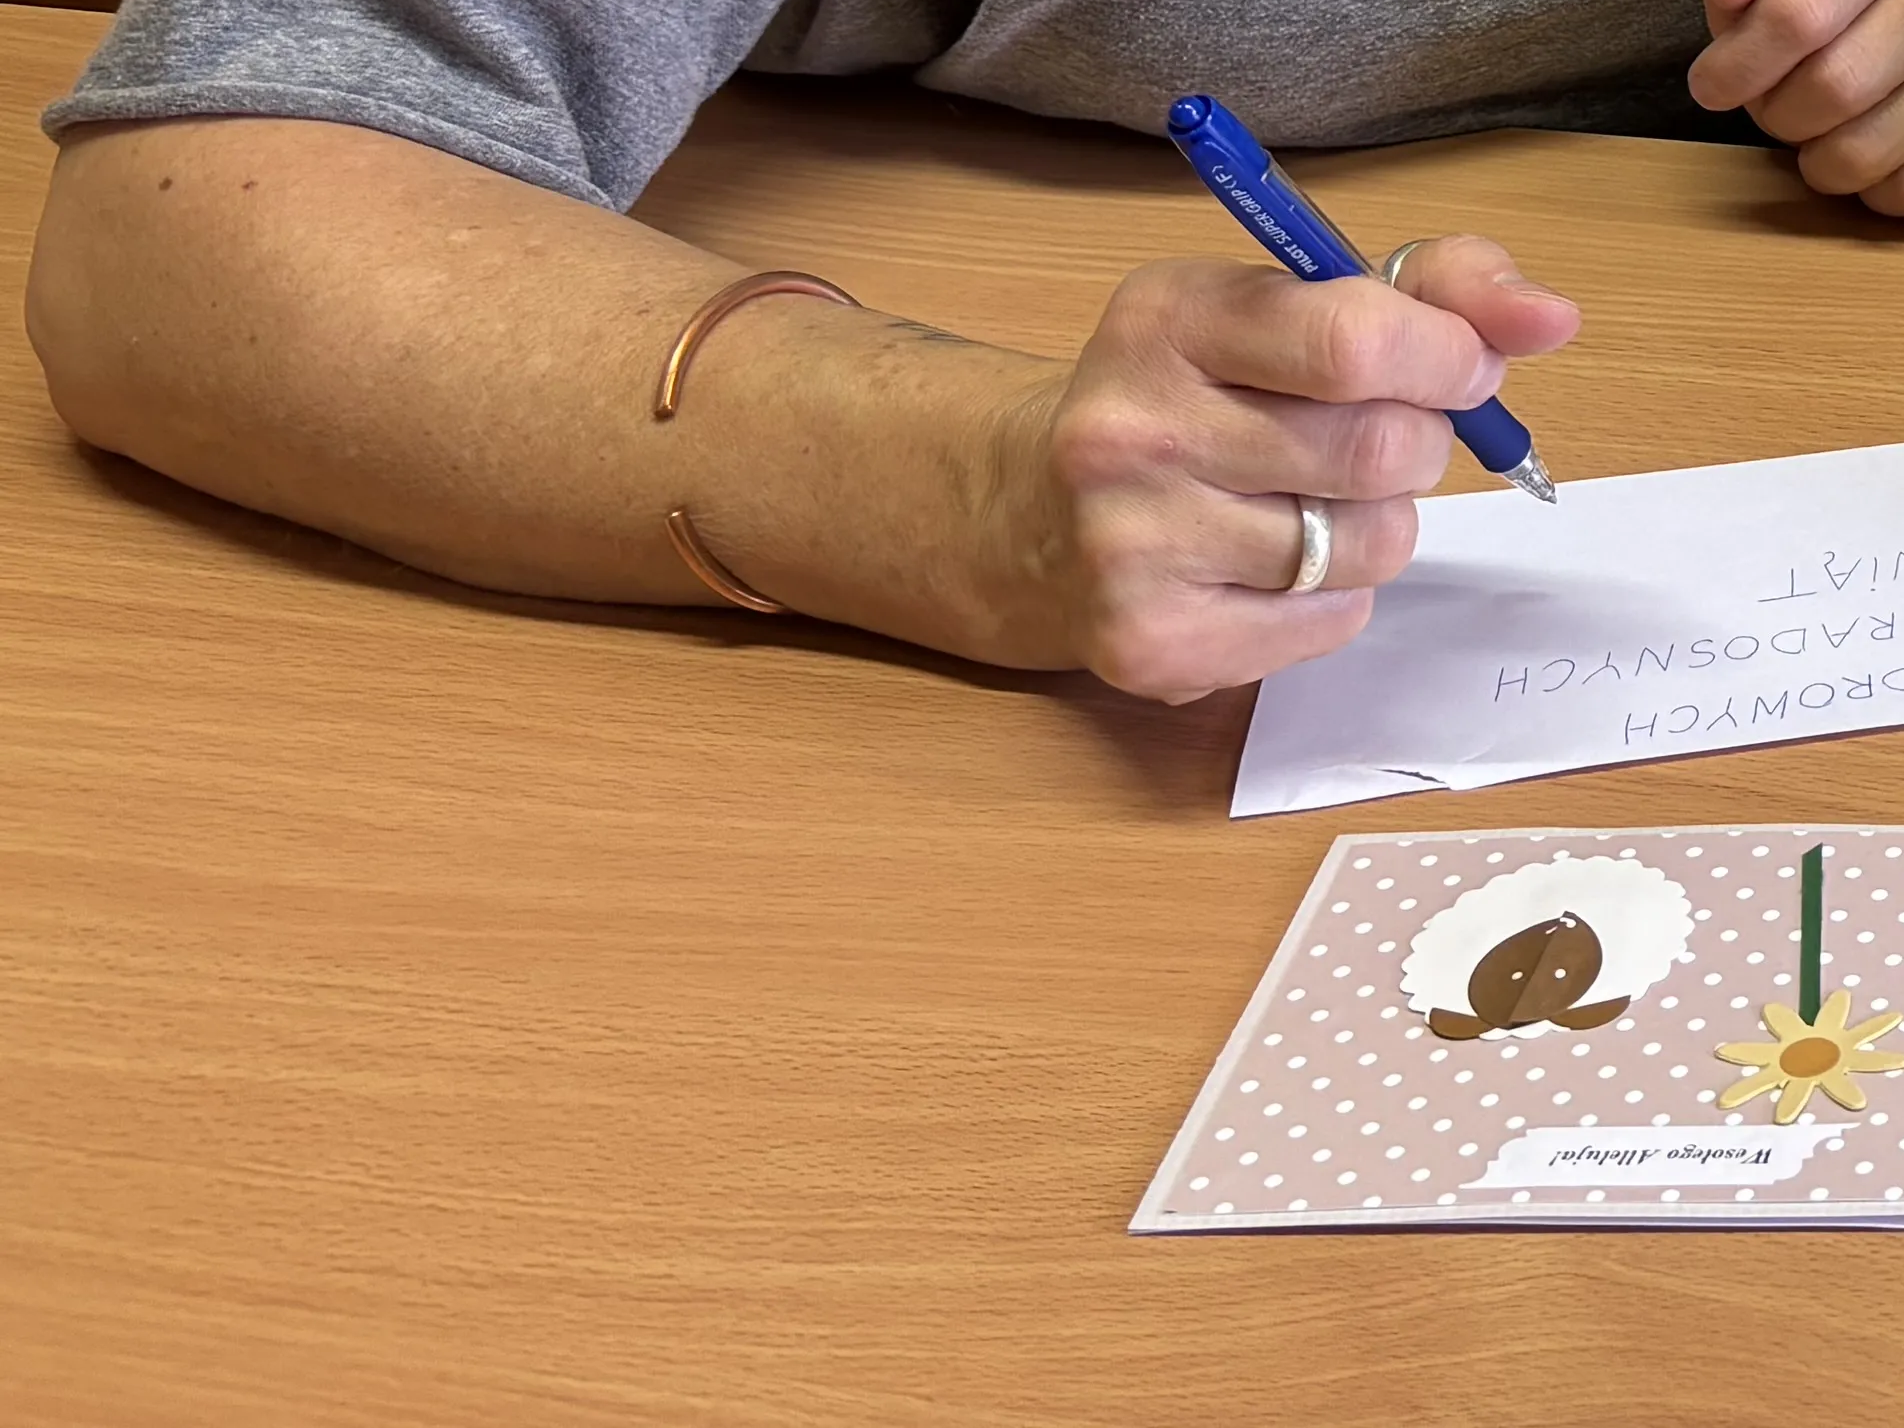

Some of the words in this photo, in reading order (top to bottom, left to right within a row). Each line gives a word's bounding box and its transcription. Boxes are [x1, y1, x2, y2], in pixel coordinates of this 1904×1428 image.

[1212, 165, 1237, 190] (F)
[1231, 189, 1261, 213] GRIP
[1254, 212, 1292, 244] SUPER
[1284, 244, 1319, 273] PILOT
[1494, 611, 1896, 702] RADOSNYCH
[1548, 1145, 1661, 1167] Alleluja!
[1667, 1144, 1773, 1165] Wesołego
